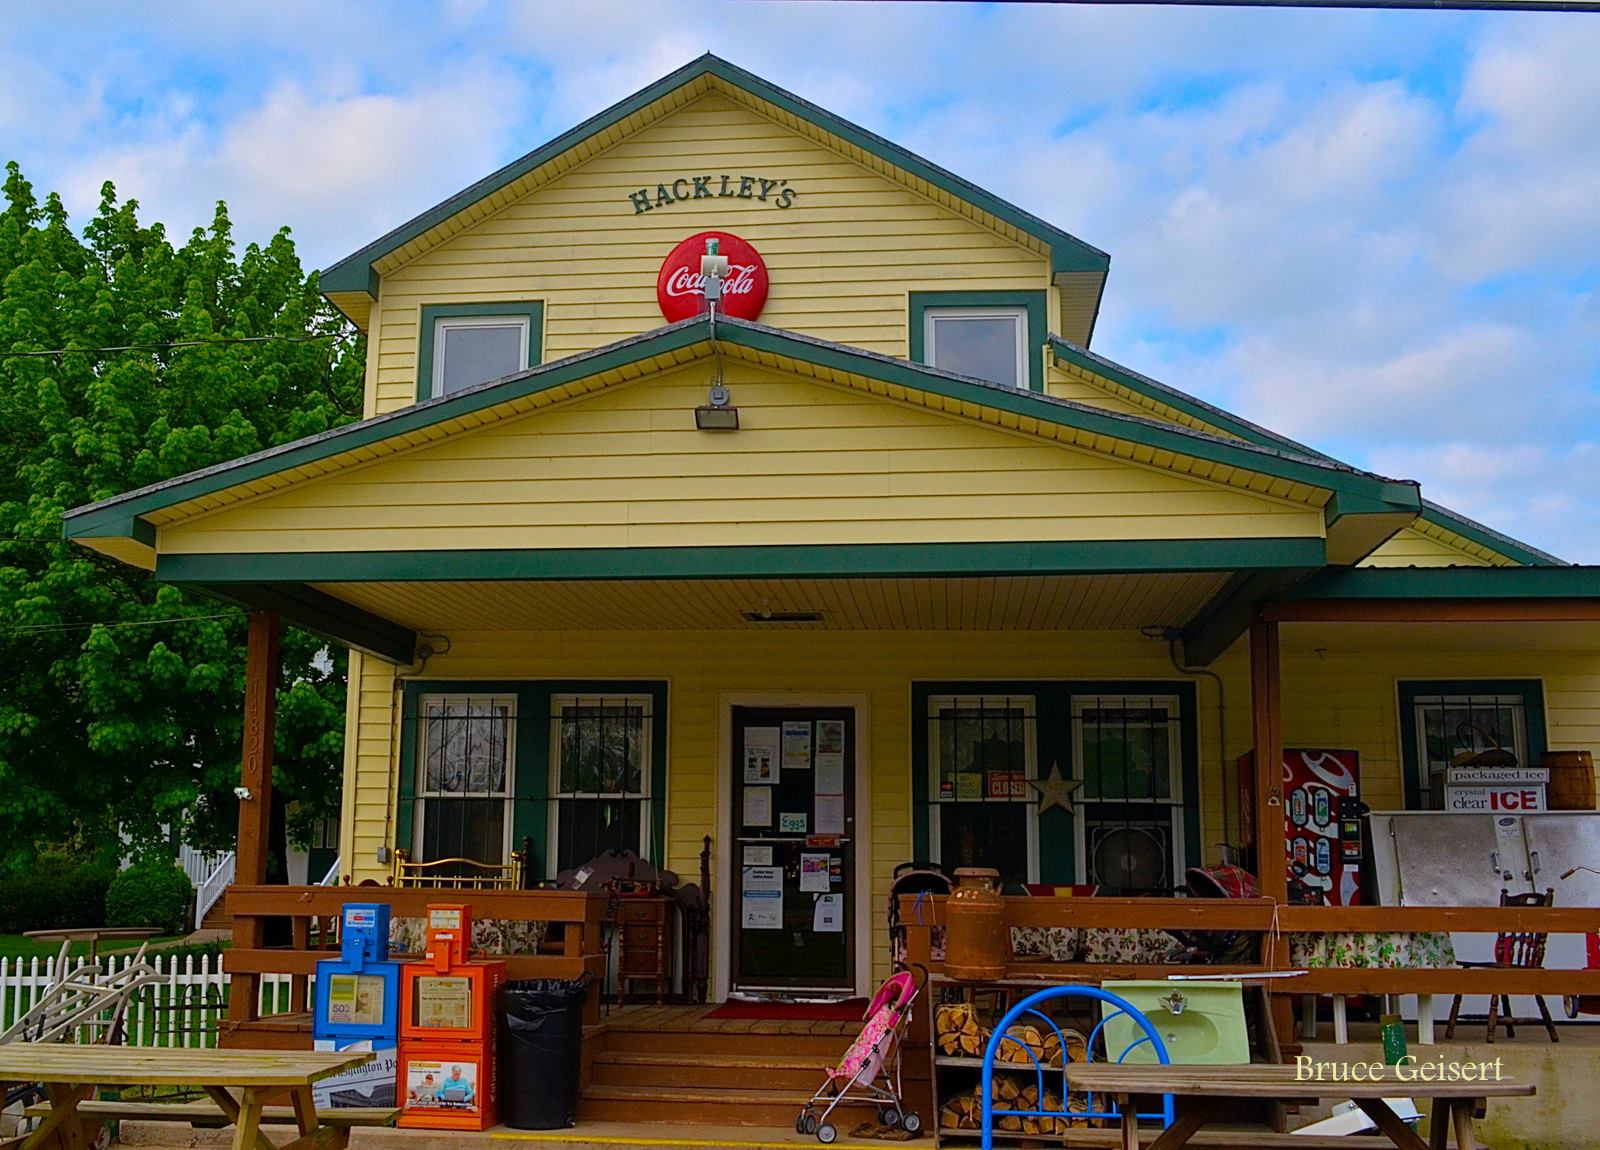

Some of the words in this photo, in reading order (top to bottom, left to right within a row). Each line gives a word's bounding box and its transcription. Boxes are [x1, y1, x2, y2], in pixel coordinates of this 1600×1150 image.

[628, 174, 797, 215] HACKLEY'S
[1455, 770, 1520, 780] packaged
[1525, 770, 1544, 779] ice
[1453, 797, 1487, 809] clear
[1490, 790, 1538, 811] ICE
[1454, 788, 1486, 797] crystal
[782, 815, 805, 831] Eggs
